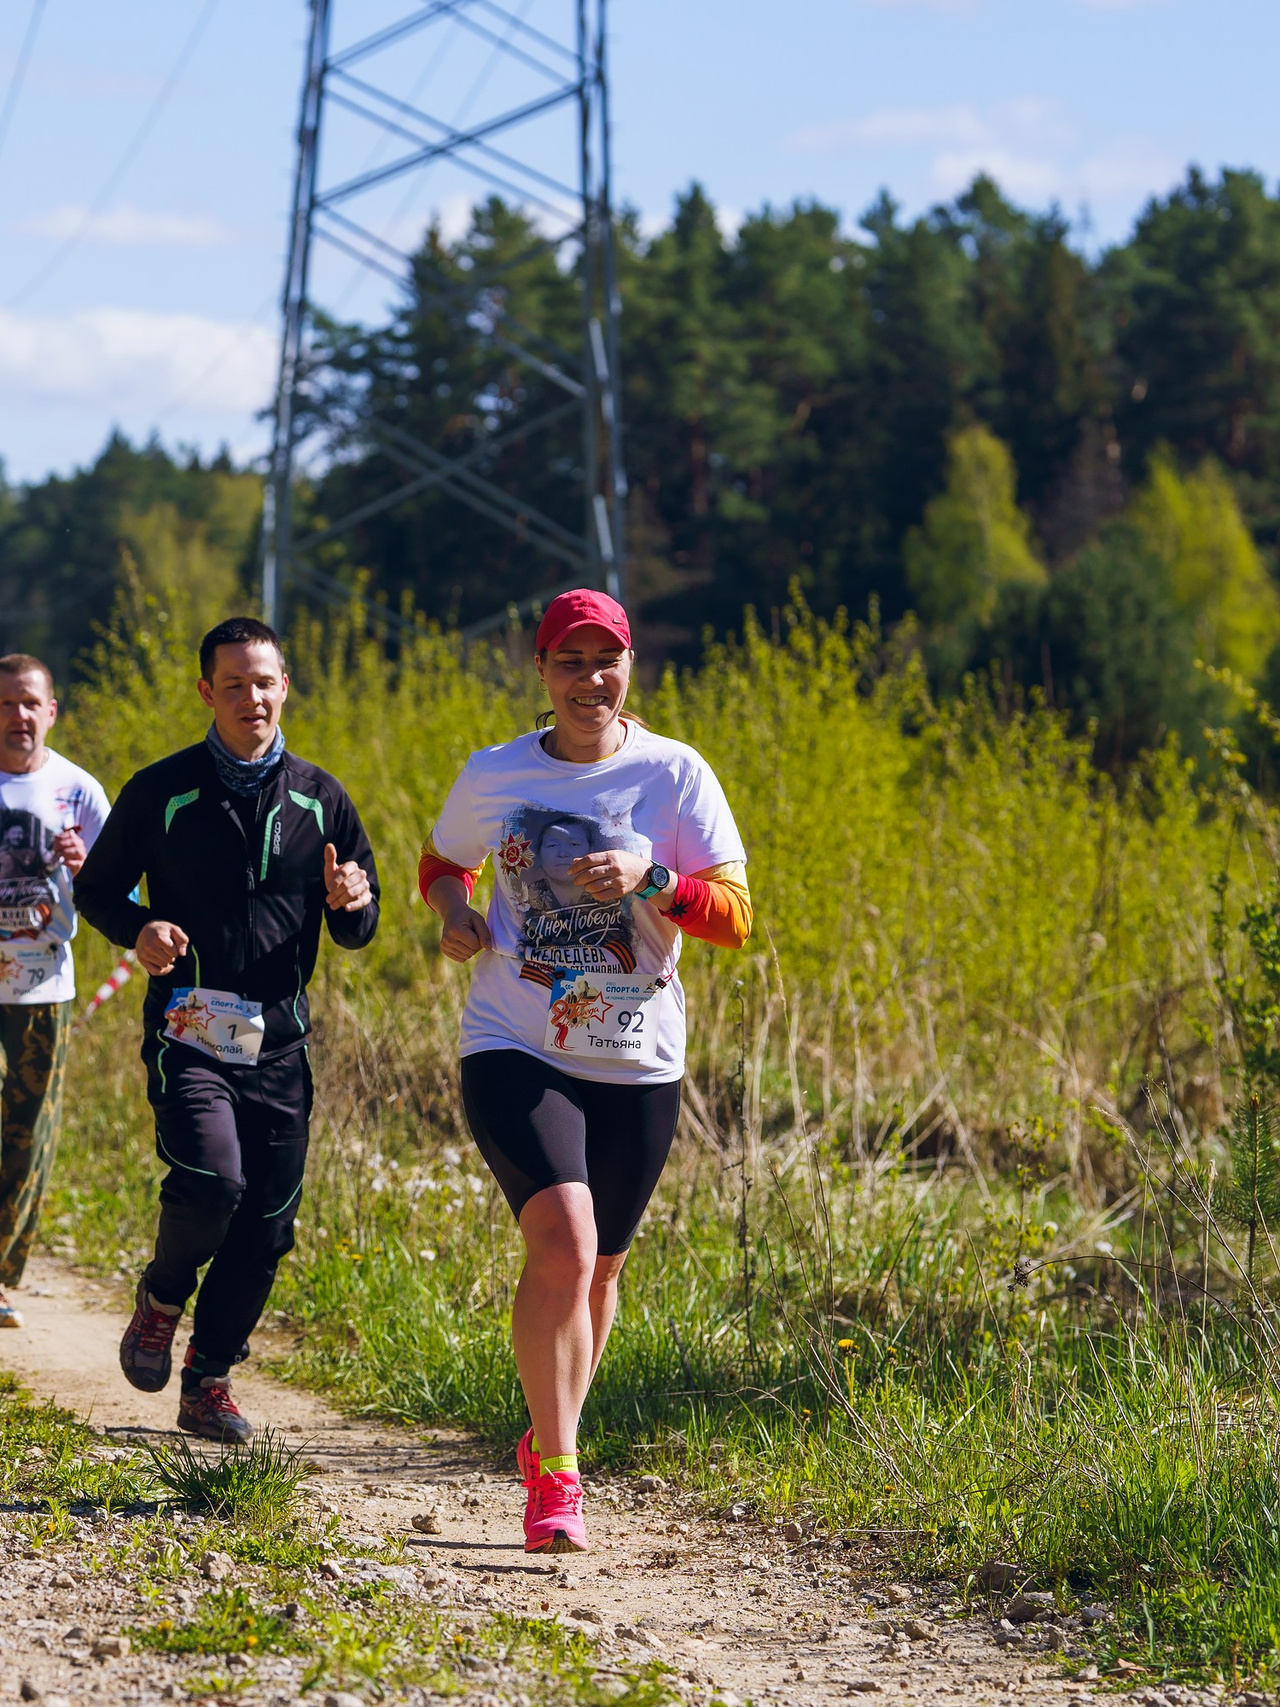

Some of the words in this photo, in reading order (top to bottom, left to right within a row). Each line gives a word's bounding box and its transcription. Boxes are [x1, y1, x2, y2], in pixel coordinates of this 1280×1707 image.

[28, 968, 45, 985] 79
[631, 986, 640, 994] 40
[210, 1000, 235, 1009] СПОРТ
[617, 1010, 645, 1033] 92
[227, 1023, 238, 1041] 1
[586, 1034, 642, 1050] Татьяна
